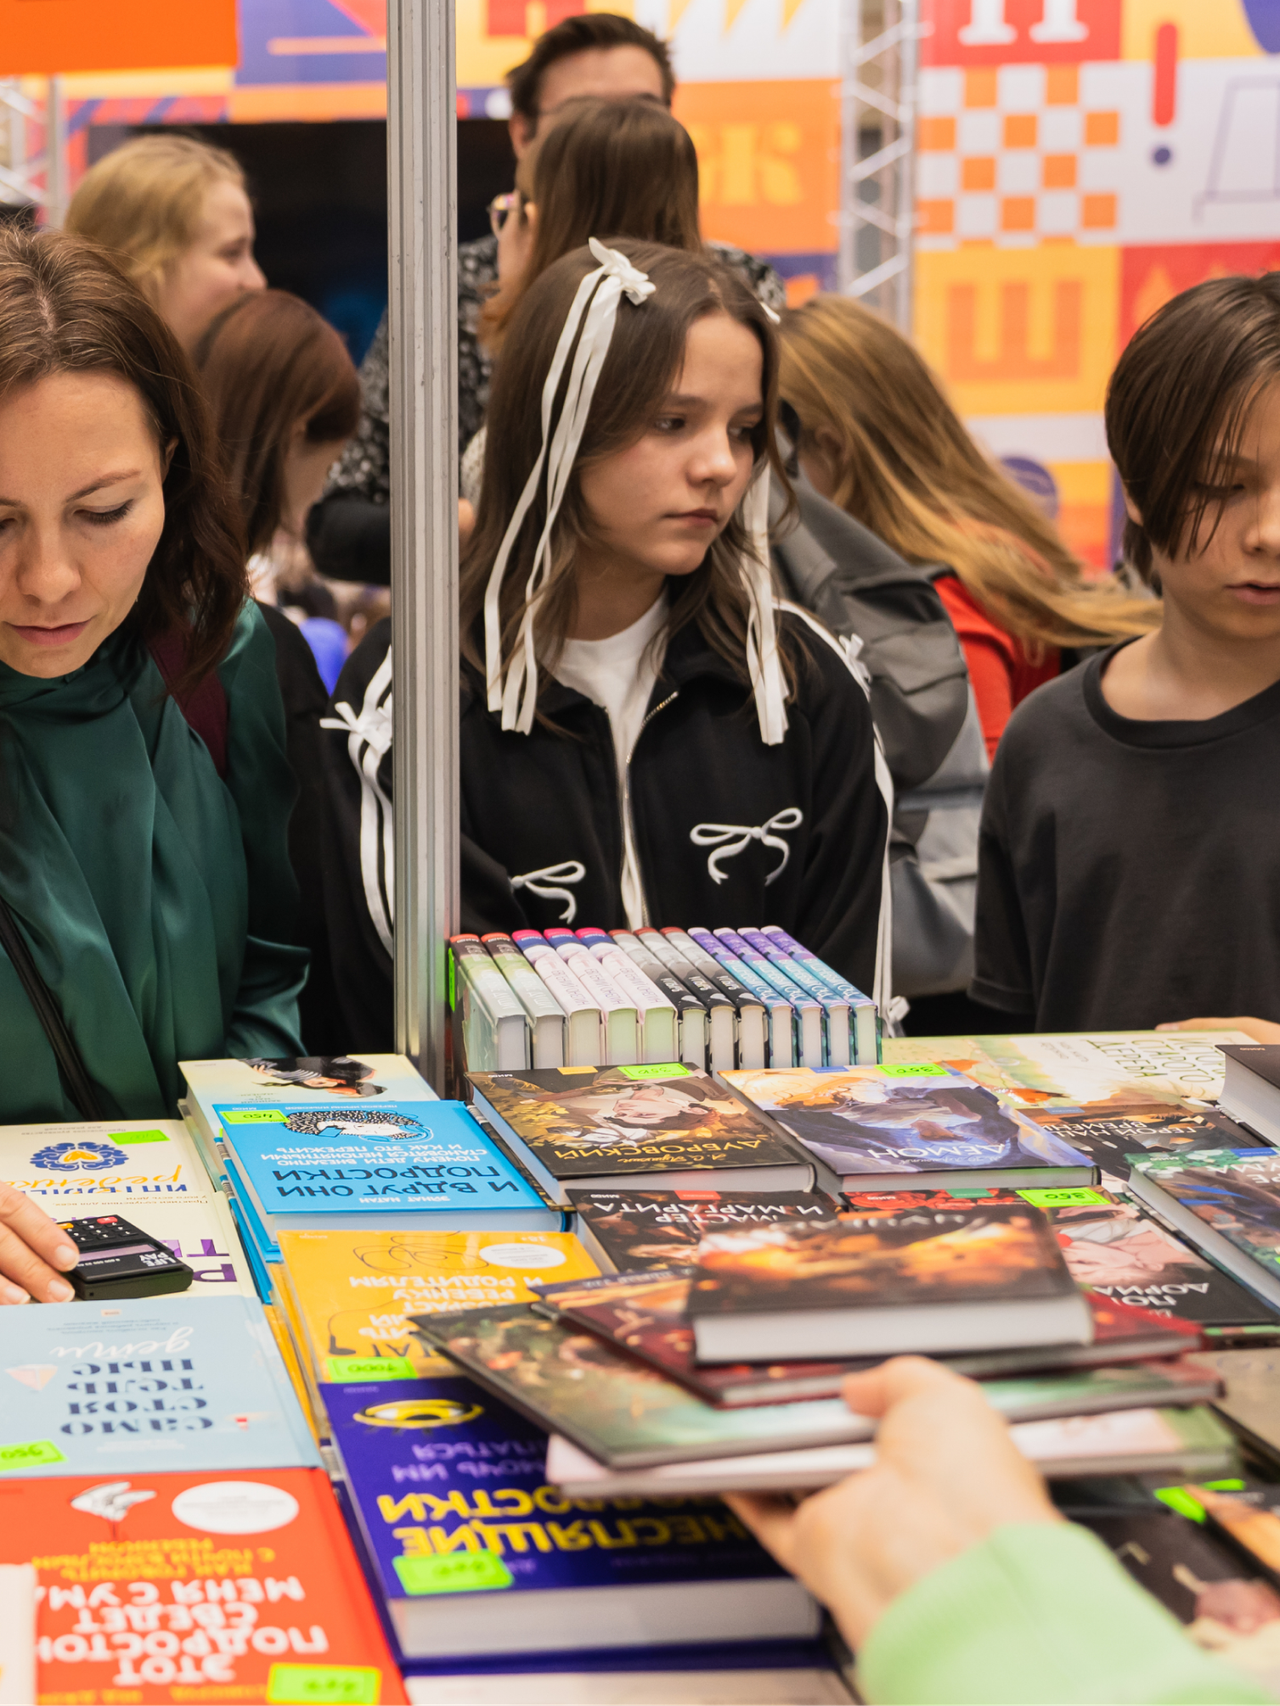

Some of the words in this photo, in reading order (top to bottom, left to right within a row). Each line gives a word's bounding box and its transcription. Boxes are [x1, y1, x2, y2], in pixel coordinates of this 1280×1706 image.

[1040, 1121, 1147, 1132] ВРЕМЕНИ
[1115, 1126, 1197, 1137] ГЕРОЙ
[260, 1151, 382, 1160] НЕПОНЯТНЫМИ
[276, 1146, 366, 1154] ПЕРЕЖИТЬ
[387, 1147, 488, 1157] СТАНОВЯТСЯ
[554, 1140, 761, 1160] ДУБРОВСКИЙ
[867, 1144, 1005, 1159] ДЕМОН
[277, 1158, 358, 1166] ВНЕЗАПНО
[363, 1156, 407, 1164] ДЕТИ
[412, 1154, 480, 1164] ПОЧЕМУ
[271, 1165, 500, 1181] ПОДРОСТКИ
[276, 1185, 353, 1197] ОНИ
[363, 1180, 475, 1197] ВДРУГ
[488, 1180, 519, 1193] И
[592, 1202, 787, 1214] МАРГАРИТА
[797, 1205, 823, 1216] И
[655, 1212, 778, 1224] МАСТЕР
[139, 1251, 169, 1262] PAY
[144, 1256, 177, 1267] LIFE
[349, 1275, 517, 1288] РОДИТЕЛЯМ
[393, 1288, 516, 1300] РЕБЕНКУ
[1092, 1282, 1210, 1296] ДОРИА
[48, 1325, 195, 1359] дети
[126, 1581, 159, 1603] С
[170, 1576, 306, 1604] МЕНЯ
[72, 1600, 259, 1634] СВЕДЕТ
[112, 1653, 235, 1687] ЭТОТ
